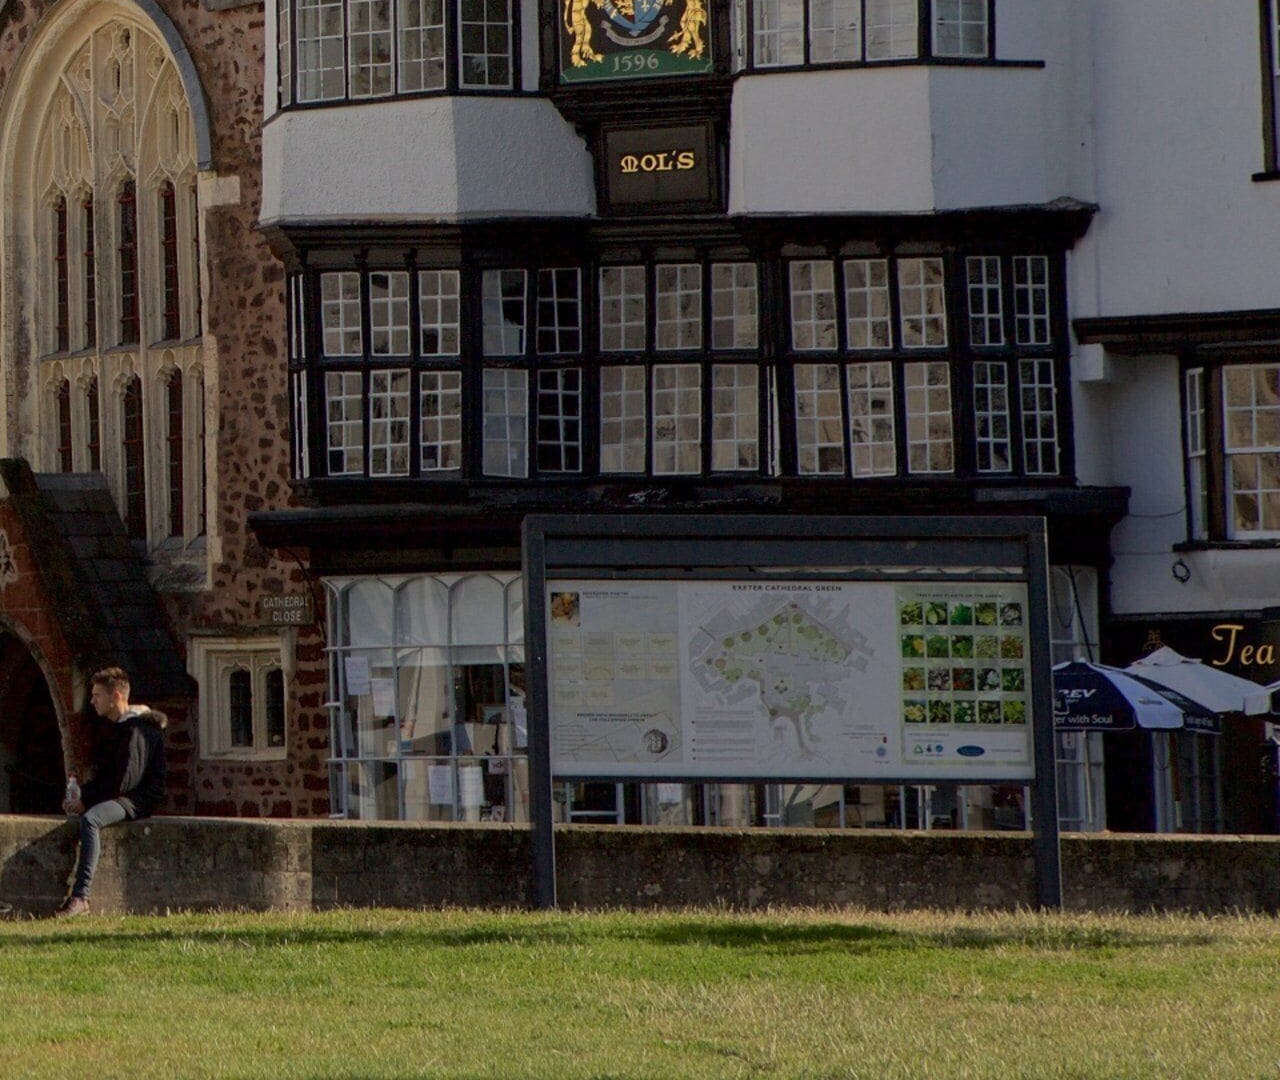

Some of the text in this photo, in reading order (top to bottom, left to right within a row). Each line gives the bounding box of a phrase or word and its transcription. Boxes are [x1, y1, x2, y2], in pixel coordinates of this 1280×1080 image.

[612, 53, 659, 72] 1596
[621, 150, 695, 173] MOL'S
[263, 596, 309, 609] CATHEDRAL
[272, 610, 302, 622] CLOSE
[1211, 624, 1275, 666] Tea
[1068, 714, 1090, 724] with
[1091, 713, 1113, 724] Soul
